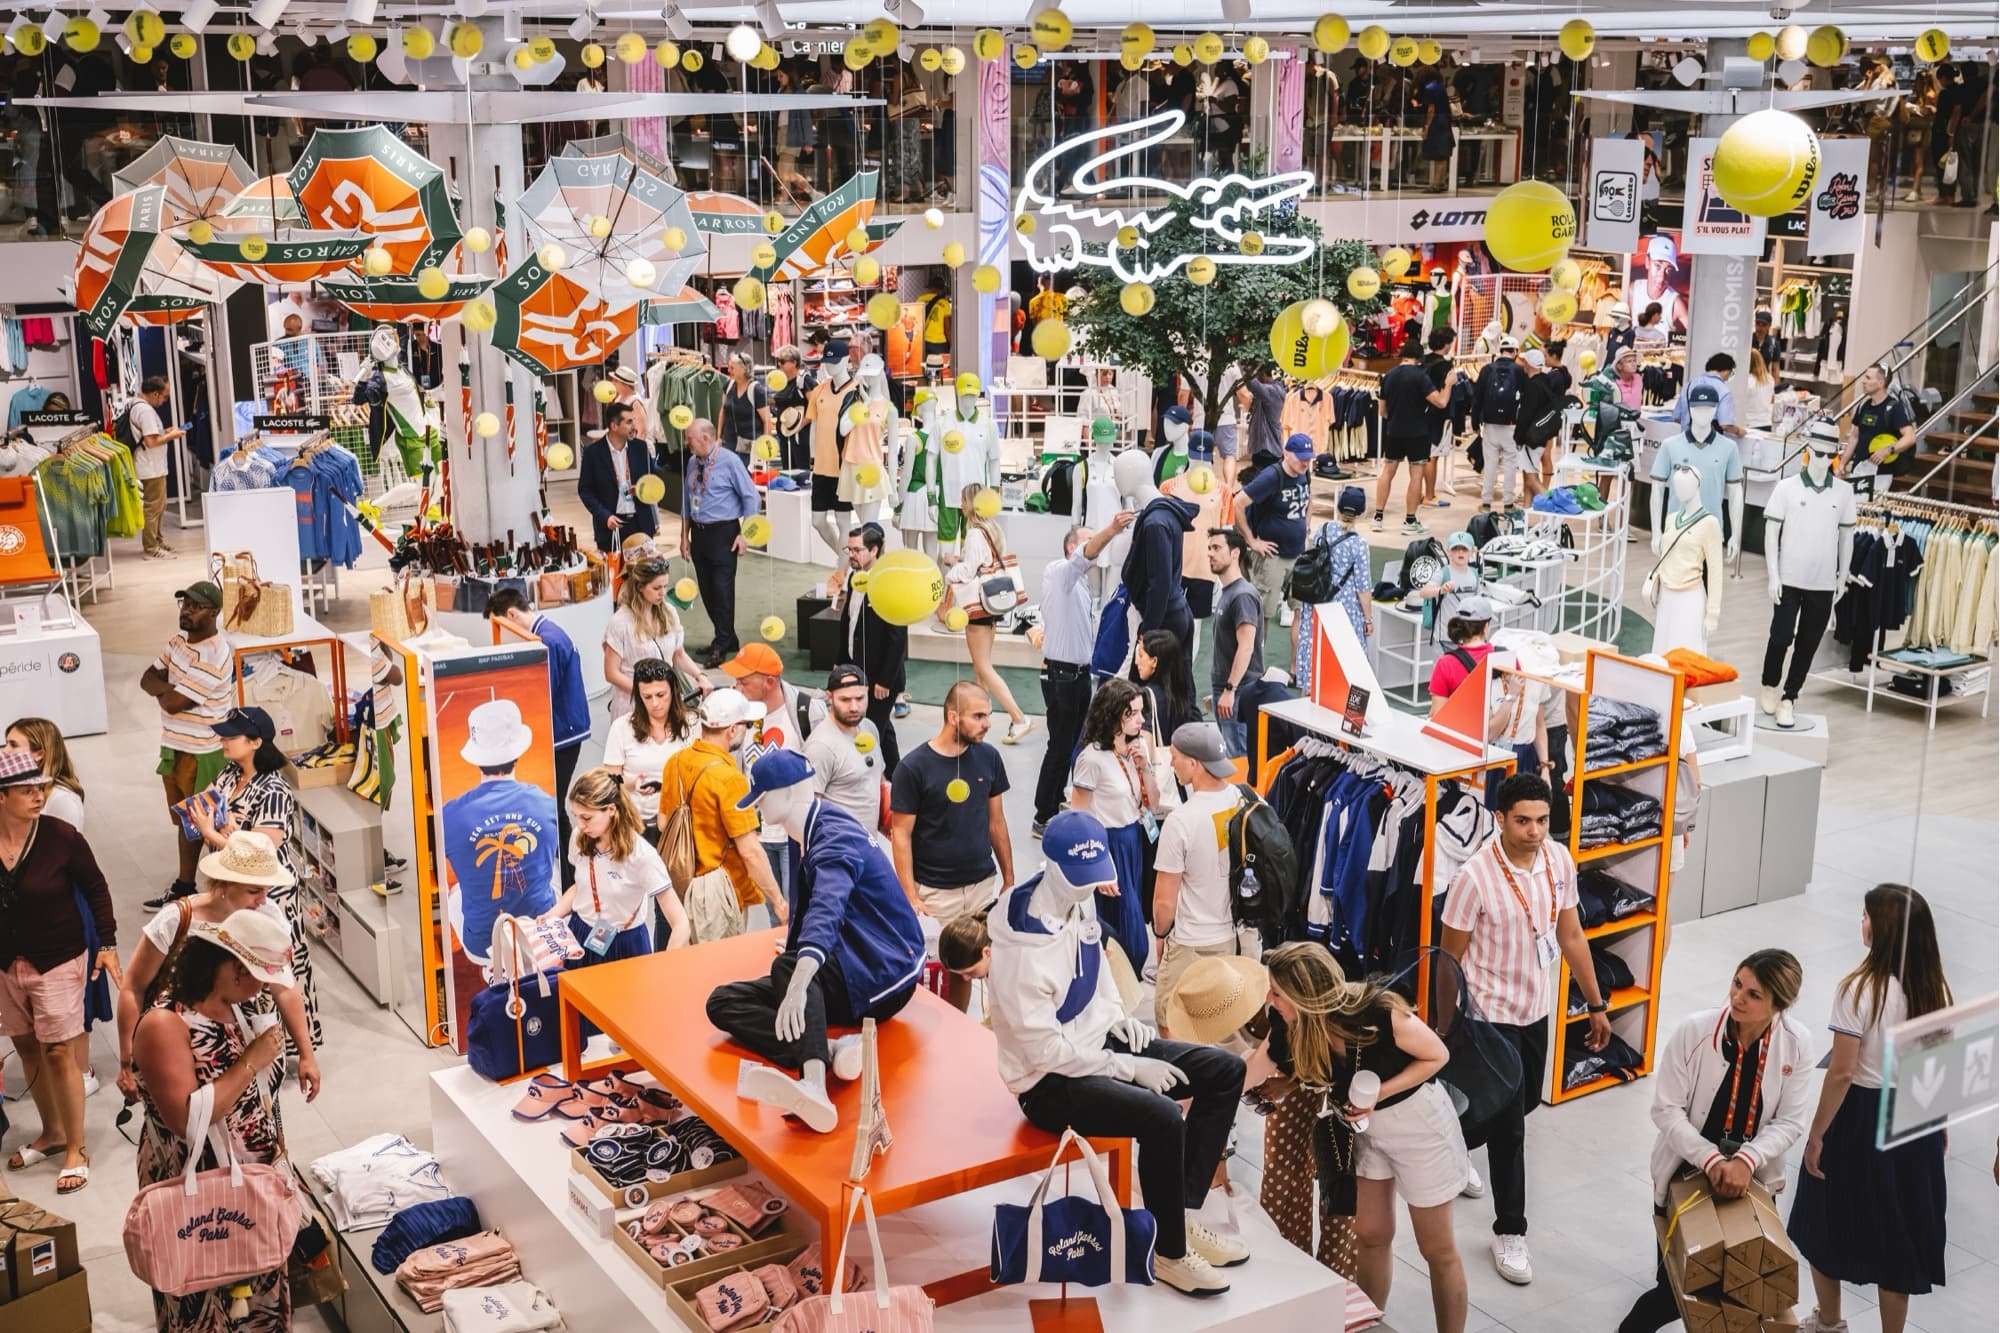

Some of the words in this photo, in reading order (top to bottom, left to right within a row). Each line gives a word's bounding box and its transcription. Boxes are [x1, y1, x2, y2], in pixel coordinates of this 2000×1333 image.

[139, 194, 154, 229] PARIS
[1731, 227, 1751, 235] PLAIT
[28, 413, 70, 422] LACOSTE
[262, 418, 304, 428] LACOSTE
[505, 812, 523, 820] AND
[177, 1208, 214, 1240] Roland
[216, 1206, 256, 1231] Garros
[199, 1227, 229, 1243] Paris
[1048, 1231, 1077, 1256] Roland
[1077, 1229, 1103, 1252] Garros
[1067, 1247, 1085, 1261] Paris
